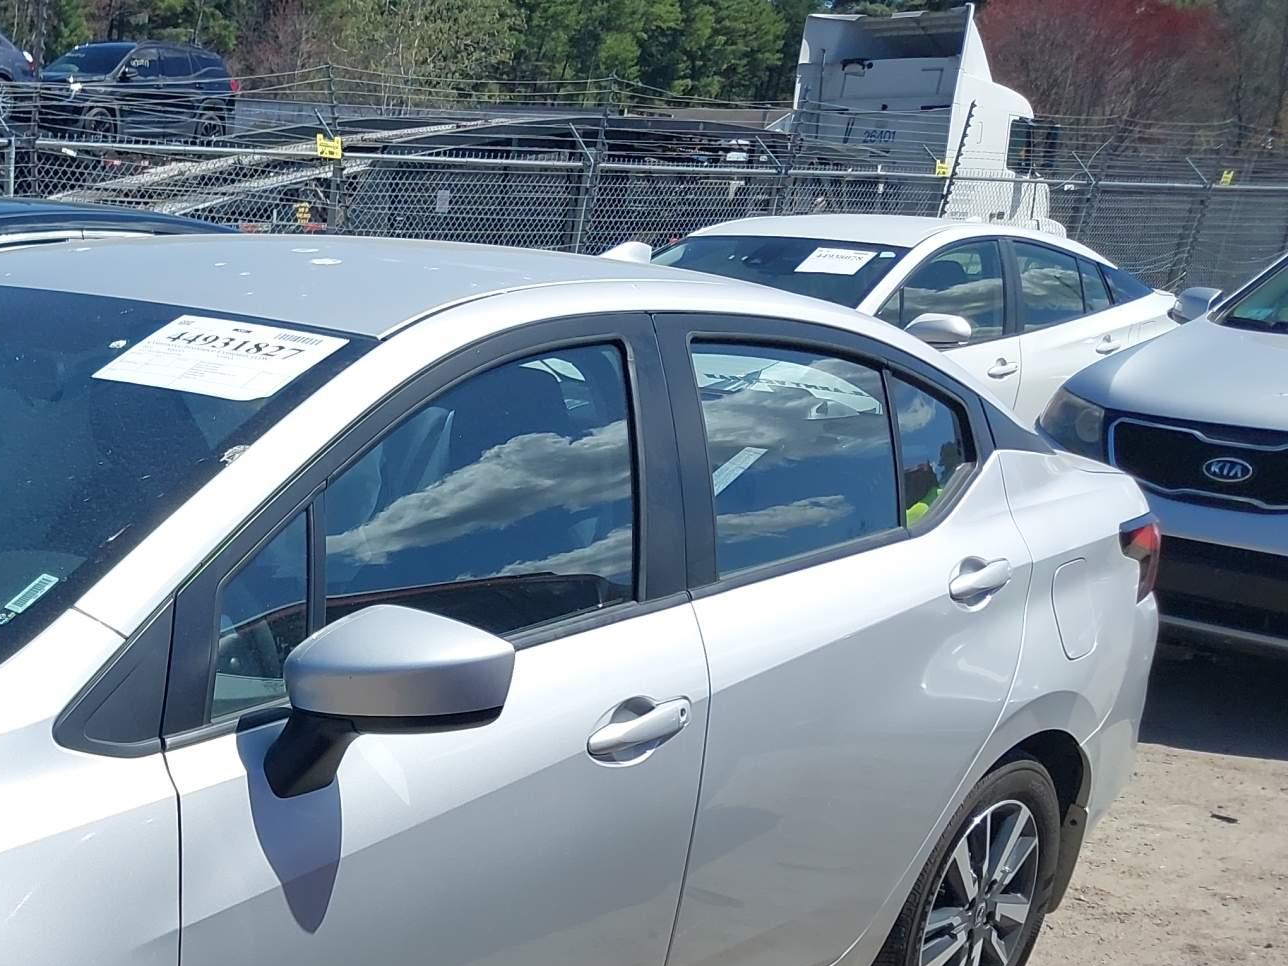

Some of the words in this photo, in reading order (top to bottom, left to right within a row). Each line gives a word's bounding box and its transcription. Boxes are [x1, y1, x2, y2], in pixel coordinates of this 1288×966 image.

[862, 129, 896, 144] 26401
[167, 331, 305, 360] 44931827
[1210, 461, 1243, 478] KIA
